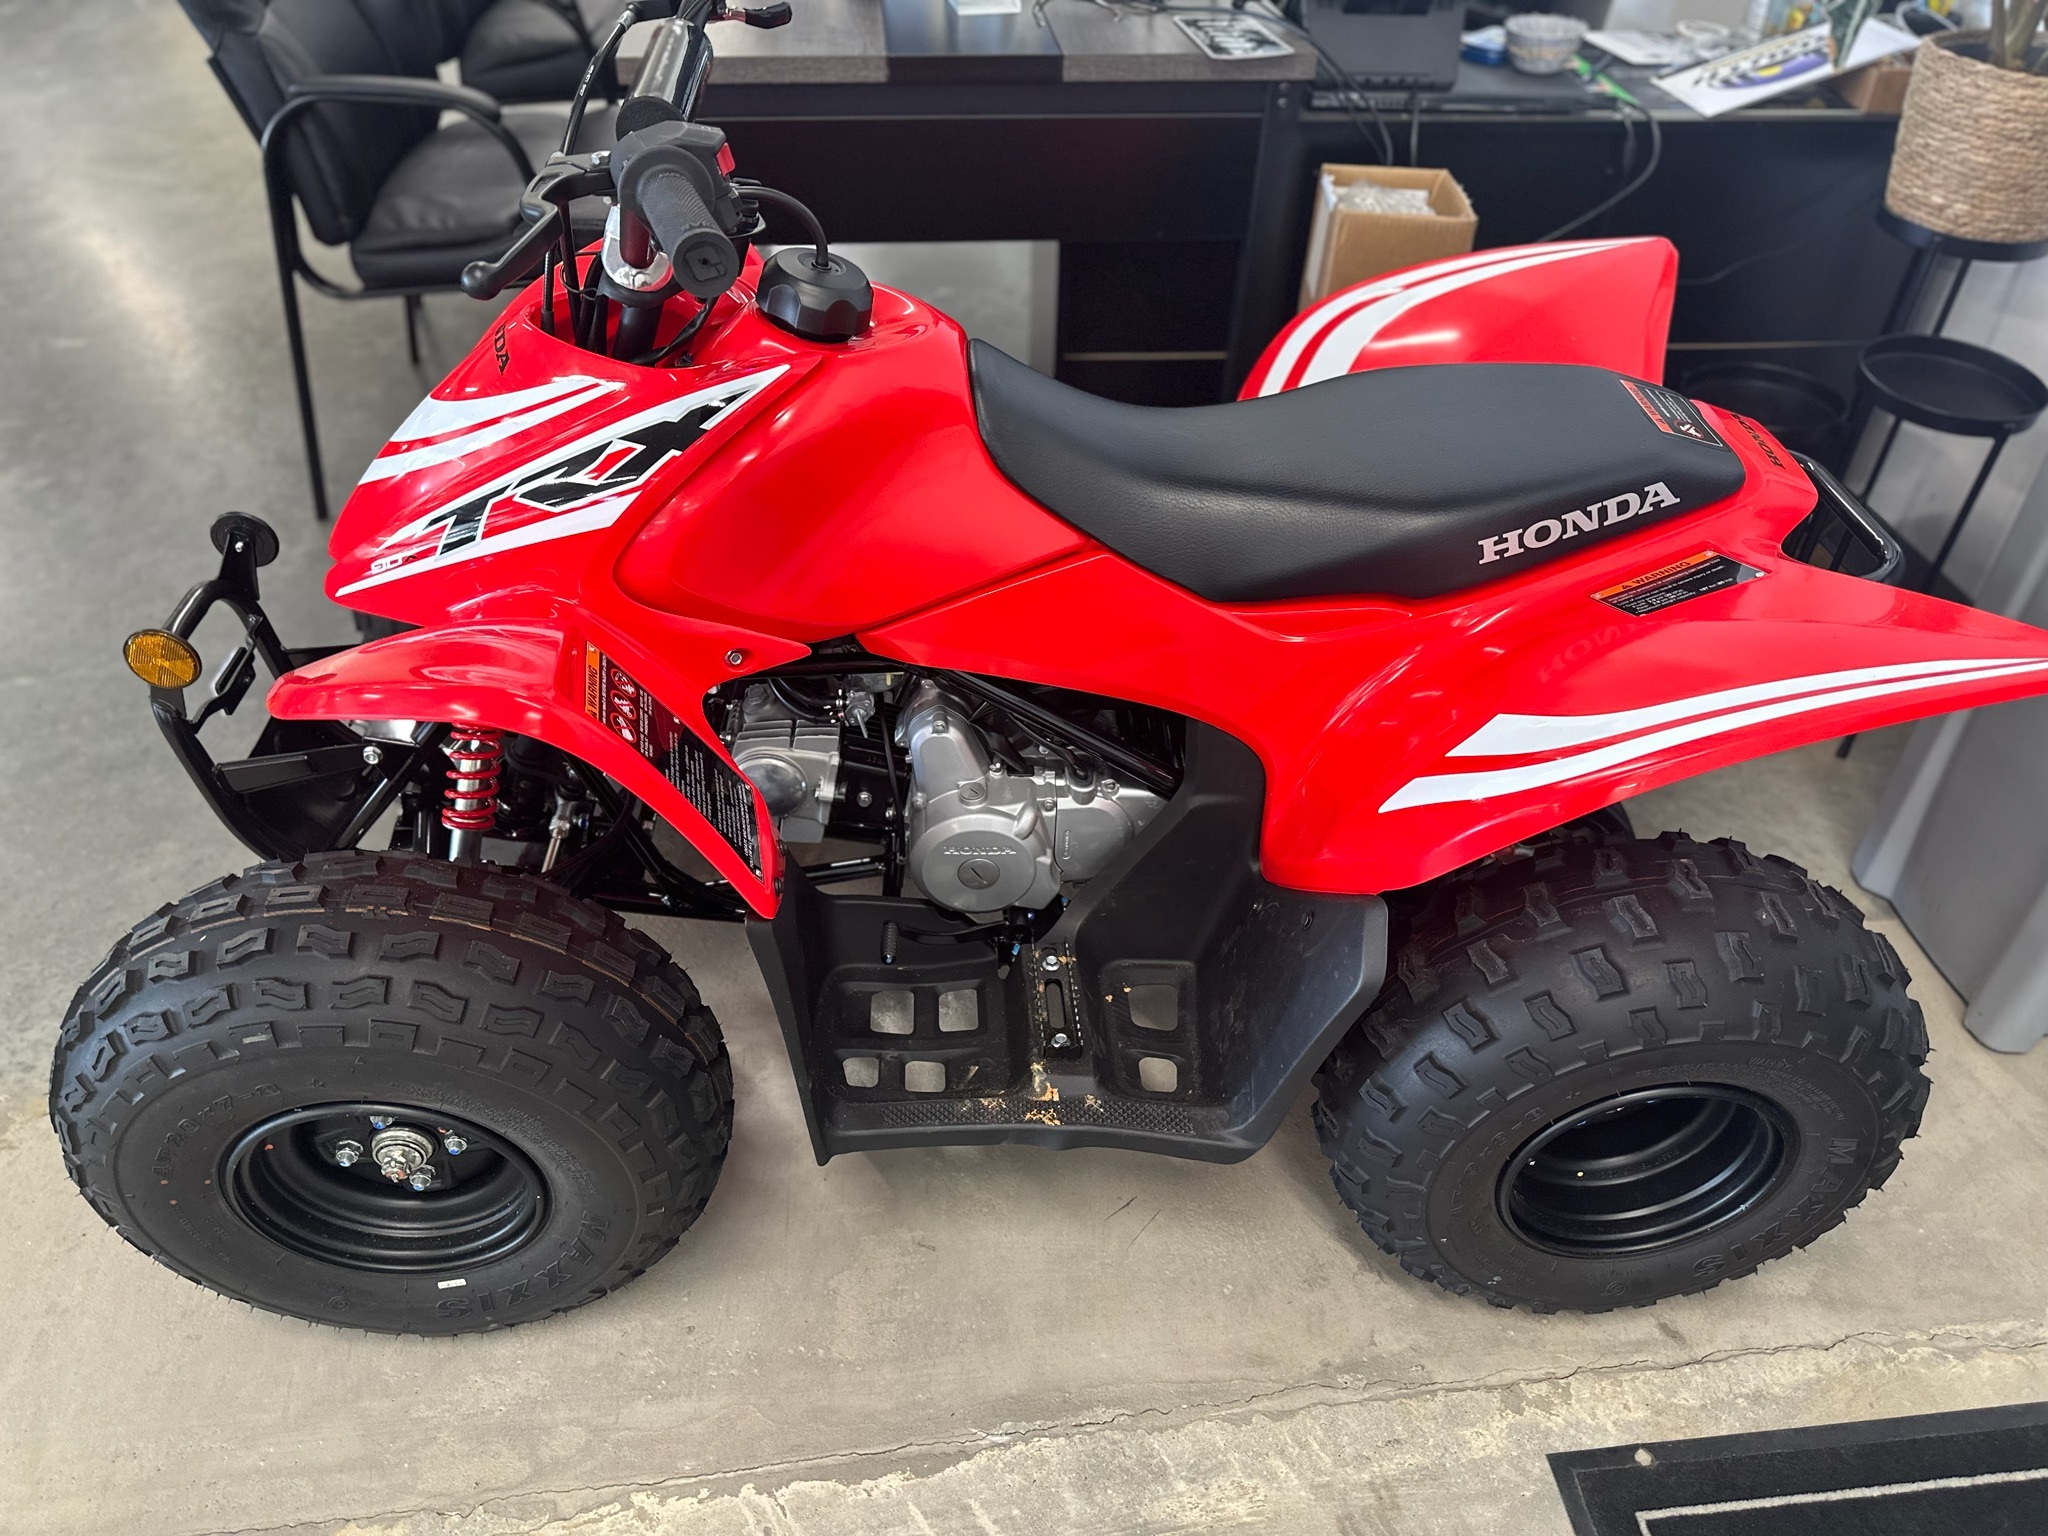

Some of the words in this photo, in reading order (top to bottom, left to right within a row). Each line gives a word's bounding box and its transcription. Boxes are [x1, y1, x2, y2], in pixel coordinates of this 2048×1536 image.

[422, 388, 753, 558] TRX
[1477, 481, 1681, 565] HONDA
[1632, 560, 1691, 586] WARNING
[588, 665, 597, 710] WARNING
[943, 846, 1017, 855] HONDA
[1691, 1137, 1860, 1277] MAXXIS
[435, 1210, 610, 1319] MAXXIS
